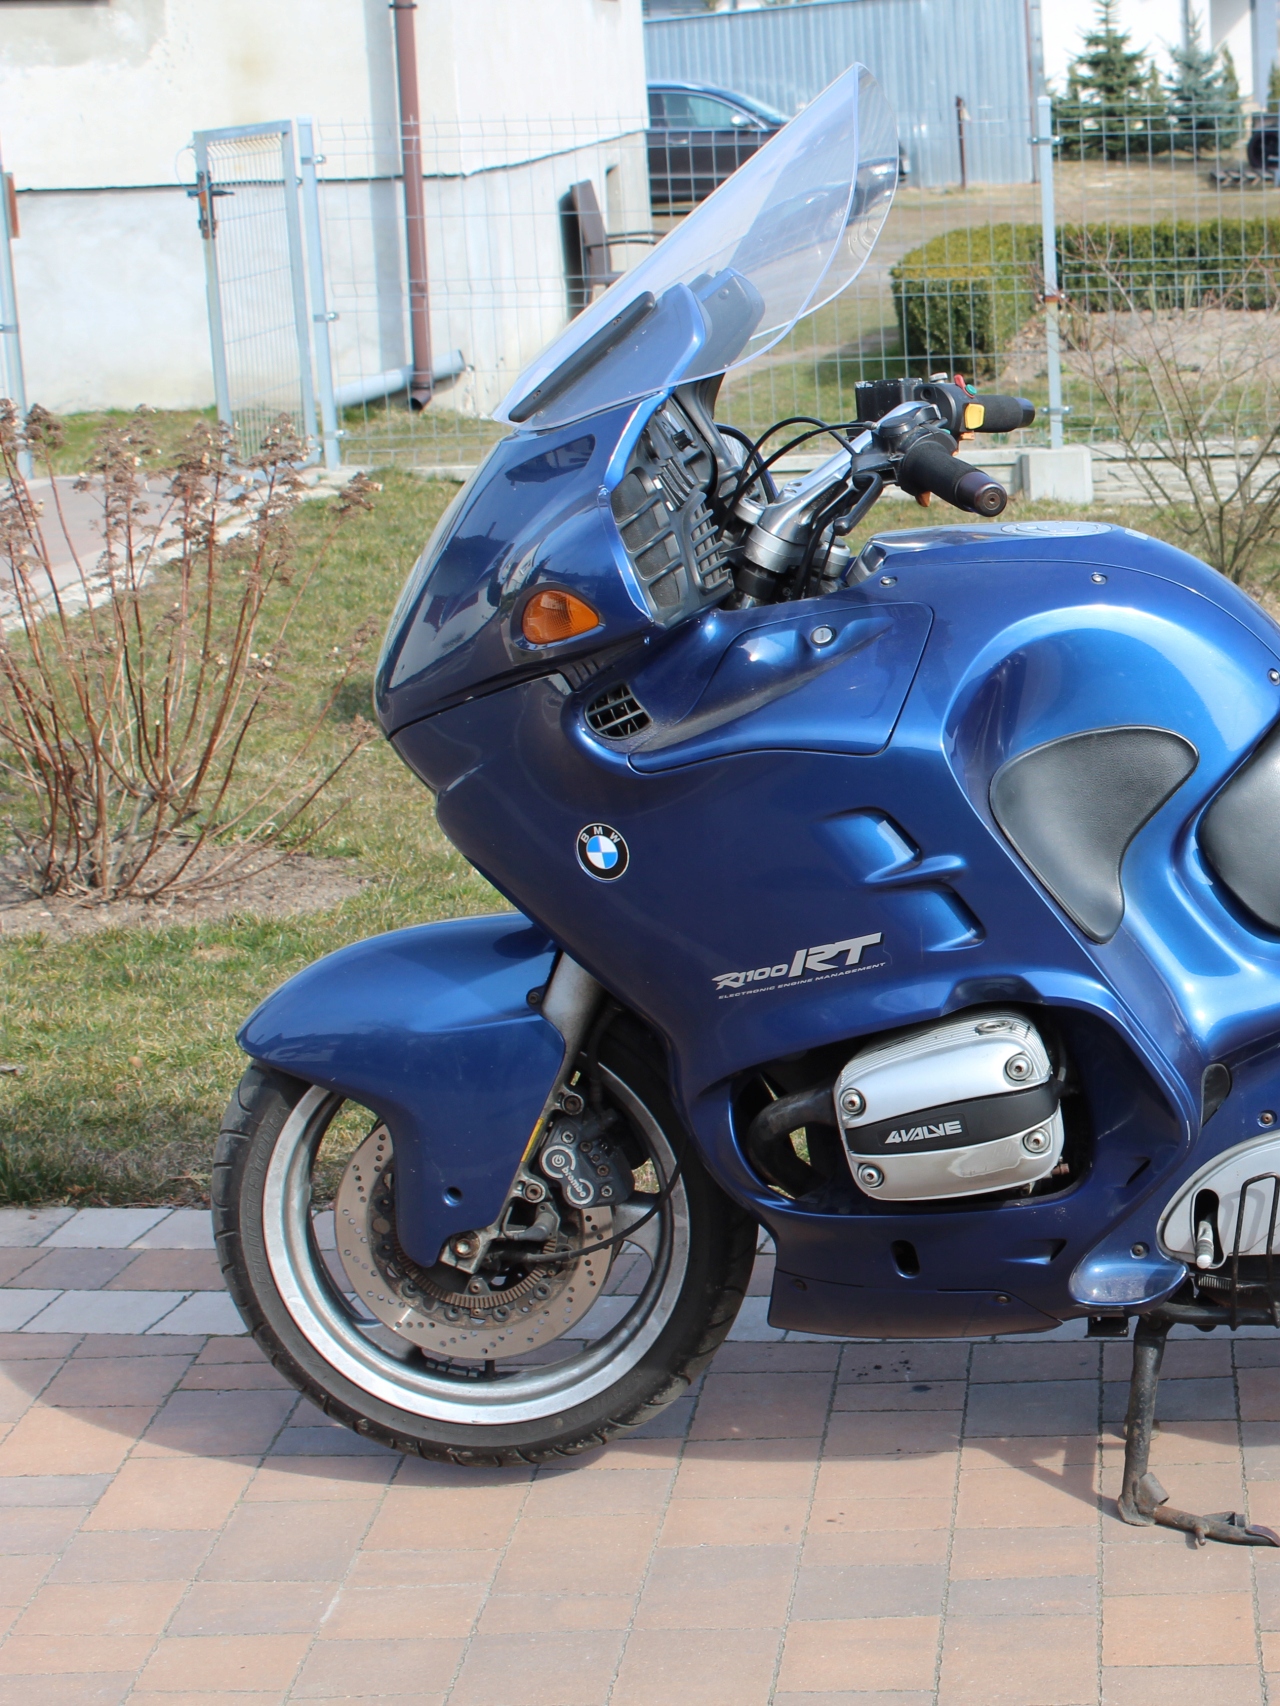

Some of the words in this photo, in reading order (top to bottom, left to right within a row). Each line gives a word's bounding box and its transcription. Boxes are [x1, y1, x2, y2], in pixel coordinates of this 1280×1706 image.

[580, 826, 621, 844] BMW
[718, 985, 776, 1000] ELECTRONIC
[777, 978, 813, 989] ENGINE
[815, 962, 887, 981] MANAGEMENT
[561, 1165, 587, 1198] brembo
